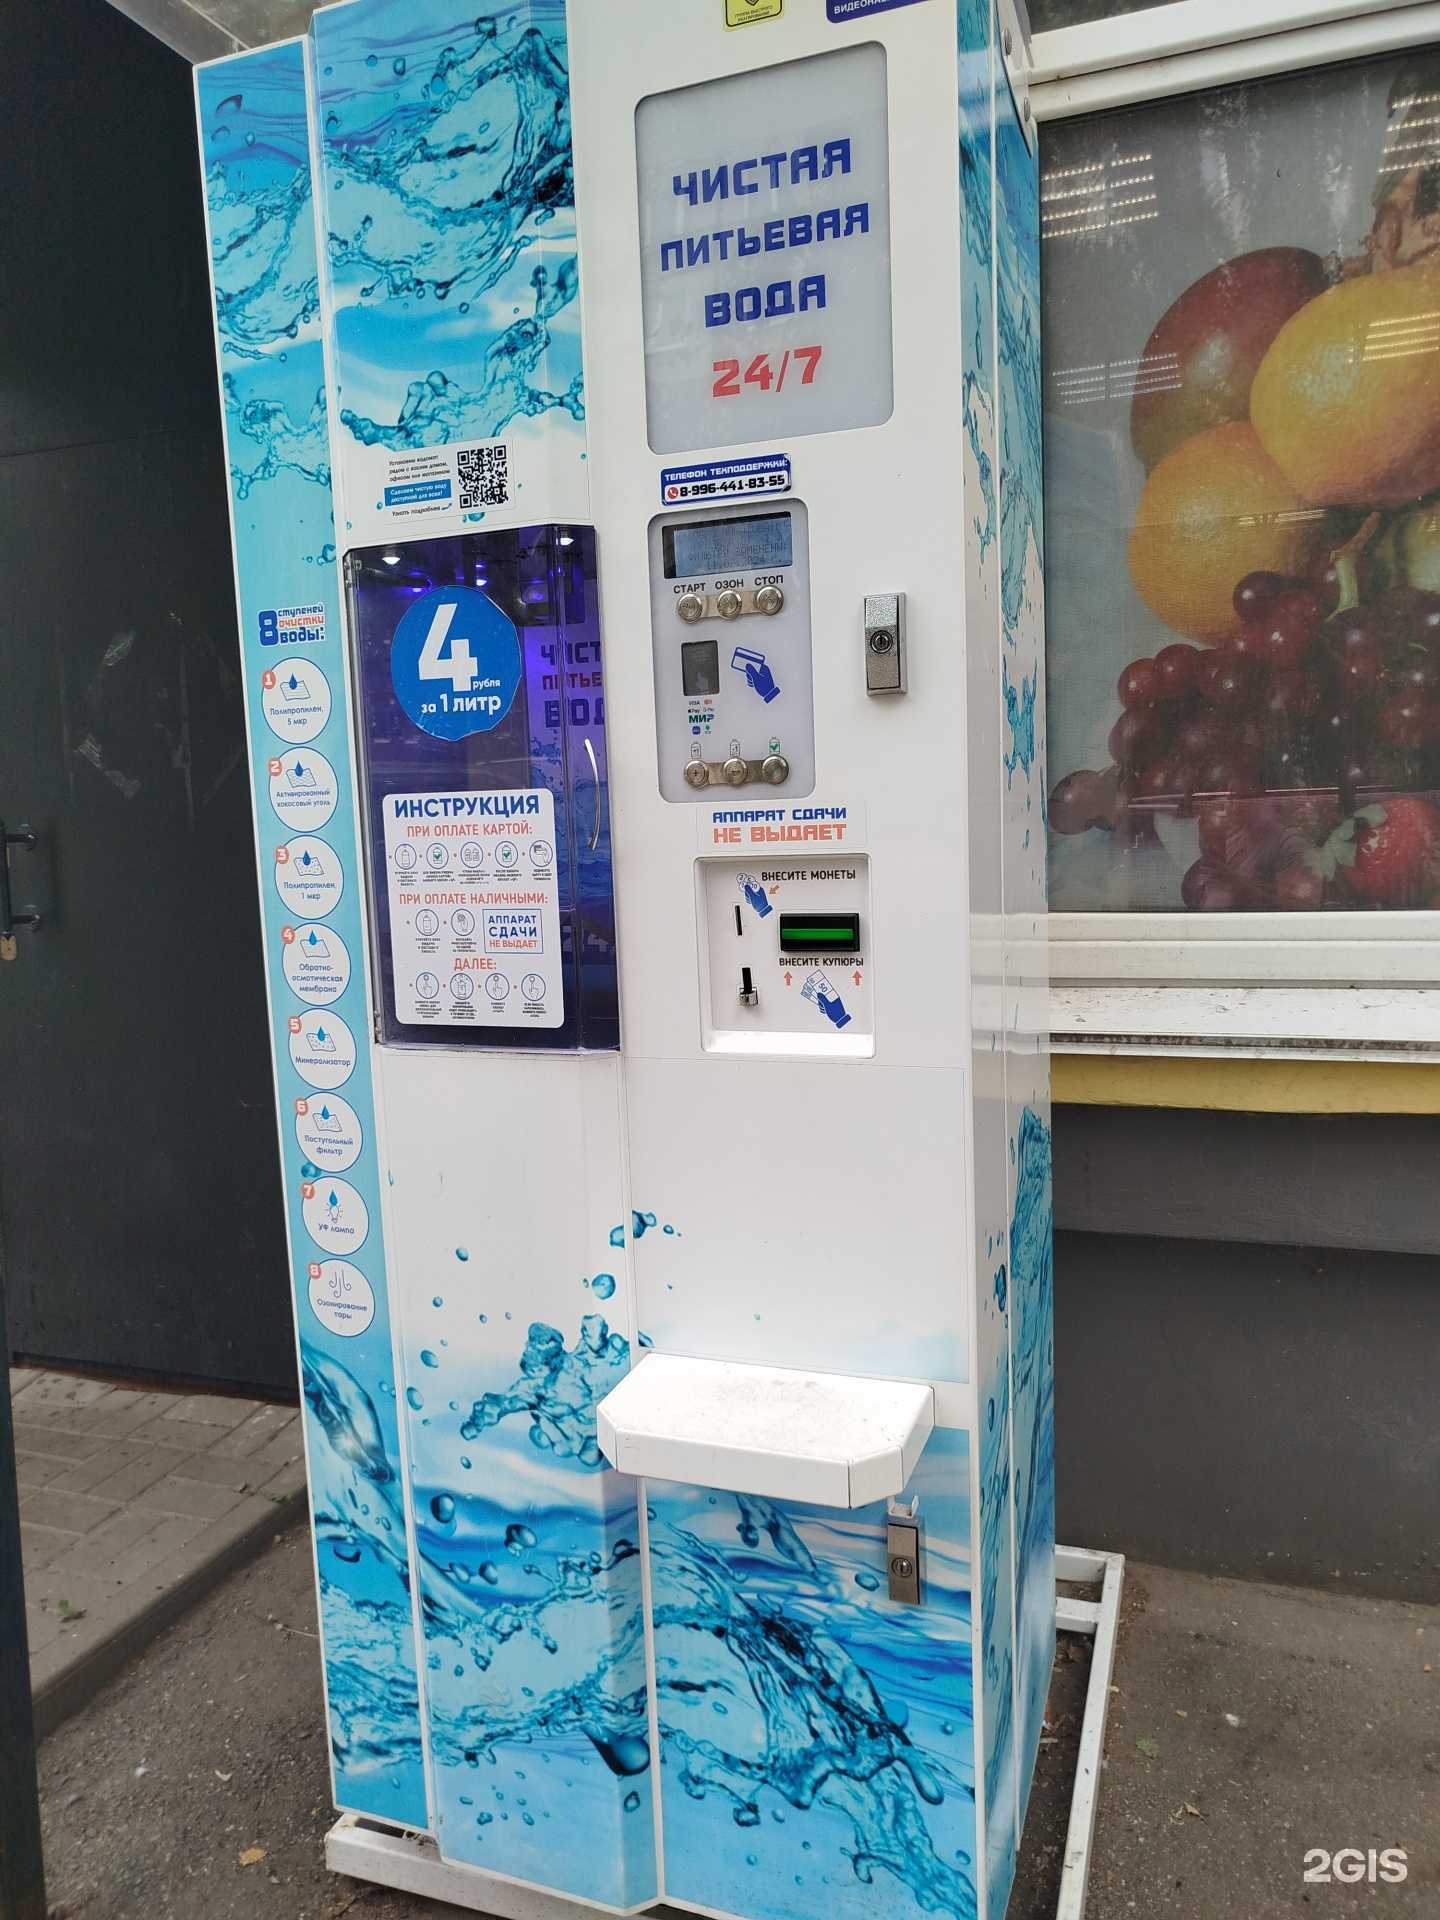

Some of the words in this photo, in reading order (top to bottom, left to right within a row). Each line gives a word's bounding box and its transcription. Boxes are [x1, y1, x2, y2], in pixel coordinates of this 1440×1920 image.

[673, 138, 851, 206] ЧИСТАЯ
[661, 203, 869, 272] ПИТЬЕВАЯ
[704, 274, 827, 328] ВОДА
[712, 345, 823, 398] 24/7
[665, 470, 707, 482] ТЕЛЕФОН
[710, 459, 788, 476] ТЕХПОДДЕРЖКИ:
[680, 474, 785, 497] 8-996-441-83-55
[673, 582, 706, 594] СТАРТ
[715, 579, 744, 590] ОЗОН
[754, 575, 784, 586] СТОП
[278, 603, 323, 617] ступеней
[279, 615, 324, 628] очистки
[259, 610, 279, 646] 8
[280, 626, 325, 644] воды:
[418, 603, 478, 692] 4
[265, 673, 272, 685] 1
[472, 678, 501, 690] рубля
[421, 703, 436, 714] за
[440, 693, 448, 712] 1
[453, 695, 501, 716] литр
[688, 714, 715, 723] МИР
[270, 761, 280, 773] 2
[277, 800, 312, 808] кокосовый
[395, 795, 539, 818] ИНСТРУКЦИЯ
[713, 810, 785, 823] АППАРАТ
[792, 807, 847, 820] СДАЧИ
[407, 825, 430, 837] ПРИ
[434, 824, 478, 837] ОПЛАТЕ
[483, 820, 533, 836] КАРТОЙ:
[714, 827, 741, 843] НЕ
[751, 824, 847, 842] ВЫДАЕТ
[277, 850, 286, 861] 3
[761, 870, 807, 882] ВНЕСИТЕ
[811, 869, 856, 880] МОНЕТЫ
[307, 893, 321, 901] мкр
[400, 894, 421, 905] ПРИ
[425, 893, 466, 904] ОПЛАТЕ
[471, 893, 548, 905] НАЛИЧНЫМИ:
[488, 915, 536, 924] АППАРАТ
[284, 930, 292, 941] 4
[488, 926, 537, 938] СДАЧИ
[489, 940, 502, 948] НЕ
[504, 939, 538, 949] ВЫДАЕТ
[299, 963, 334, 973] Обратно-
[454, 958, 497, 971] ДАЛЕЕ:
[779, 958, 820, 967] ВНЕСИТЕ
[823, 957, 864, 967] КУПЮРЫ
[292, 975, 343, 983] осмотическая
[300, 985, 337, 993] мембрана
[290, 1019, 299, 1031] 5
[295, 1056, 351, 1067] Минерализатор
[297, 1101, 306, 1113] 6
[304, 1135, 354, 1146] Постугольный
[316, 1147, 343, 1156] фильтр
[304, 1185, 312, 1197] 7
[318, 1223, 328, 1232] УФ
[330, 1225, 355, 1235] лампа
[310, 1264, 319, 1277] 8
[317, 1298, 368, 1312] Озонирование
[334, 1310, 352, 1320] тары
